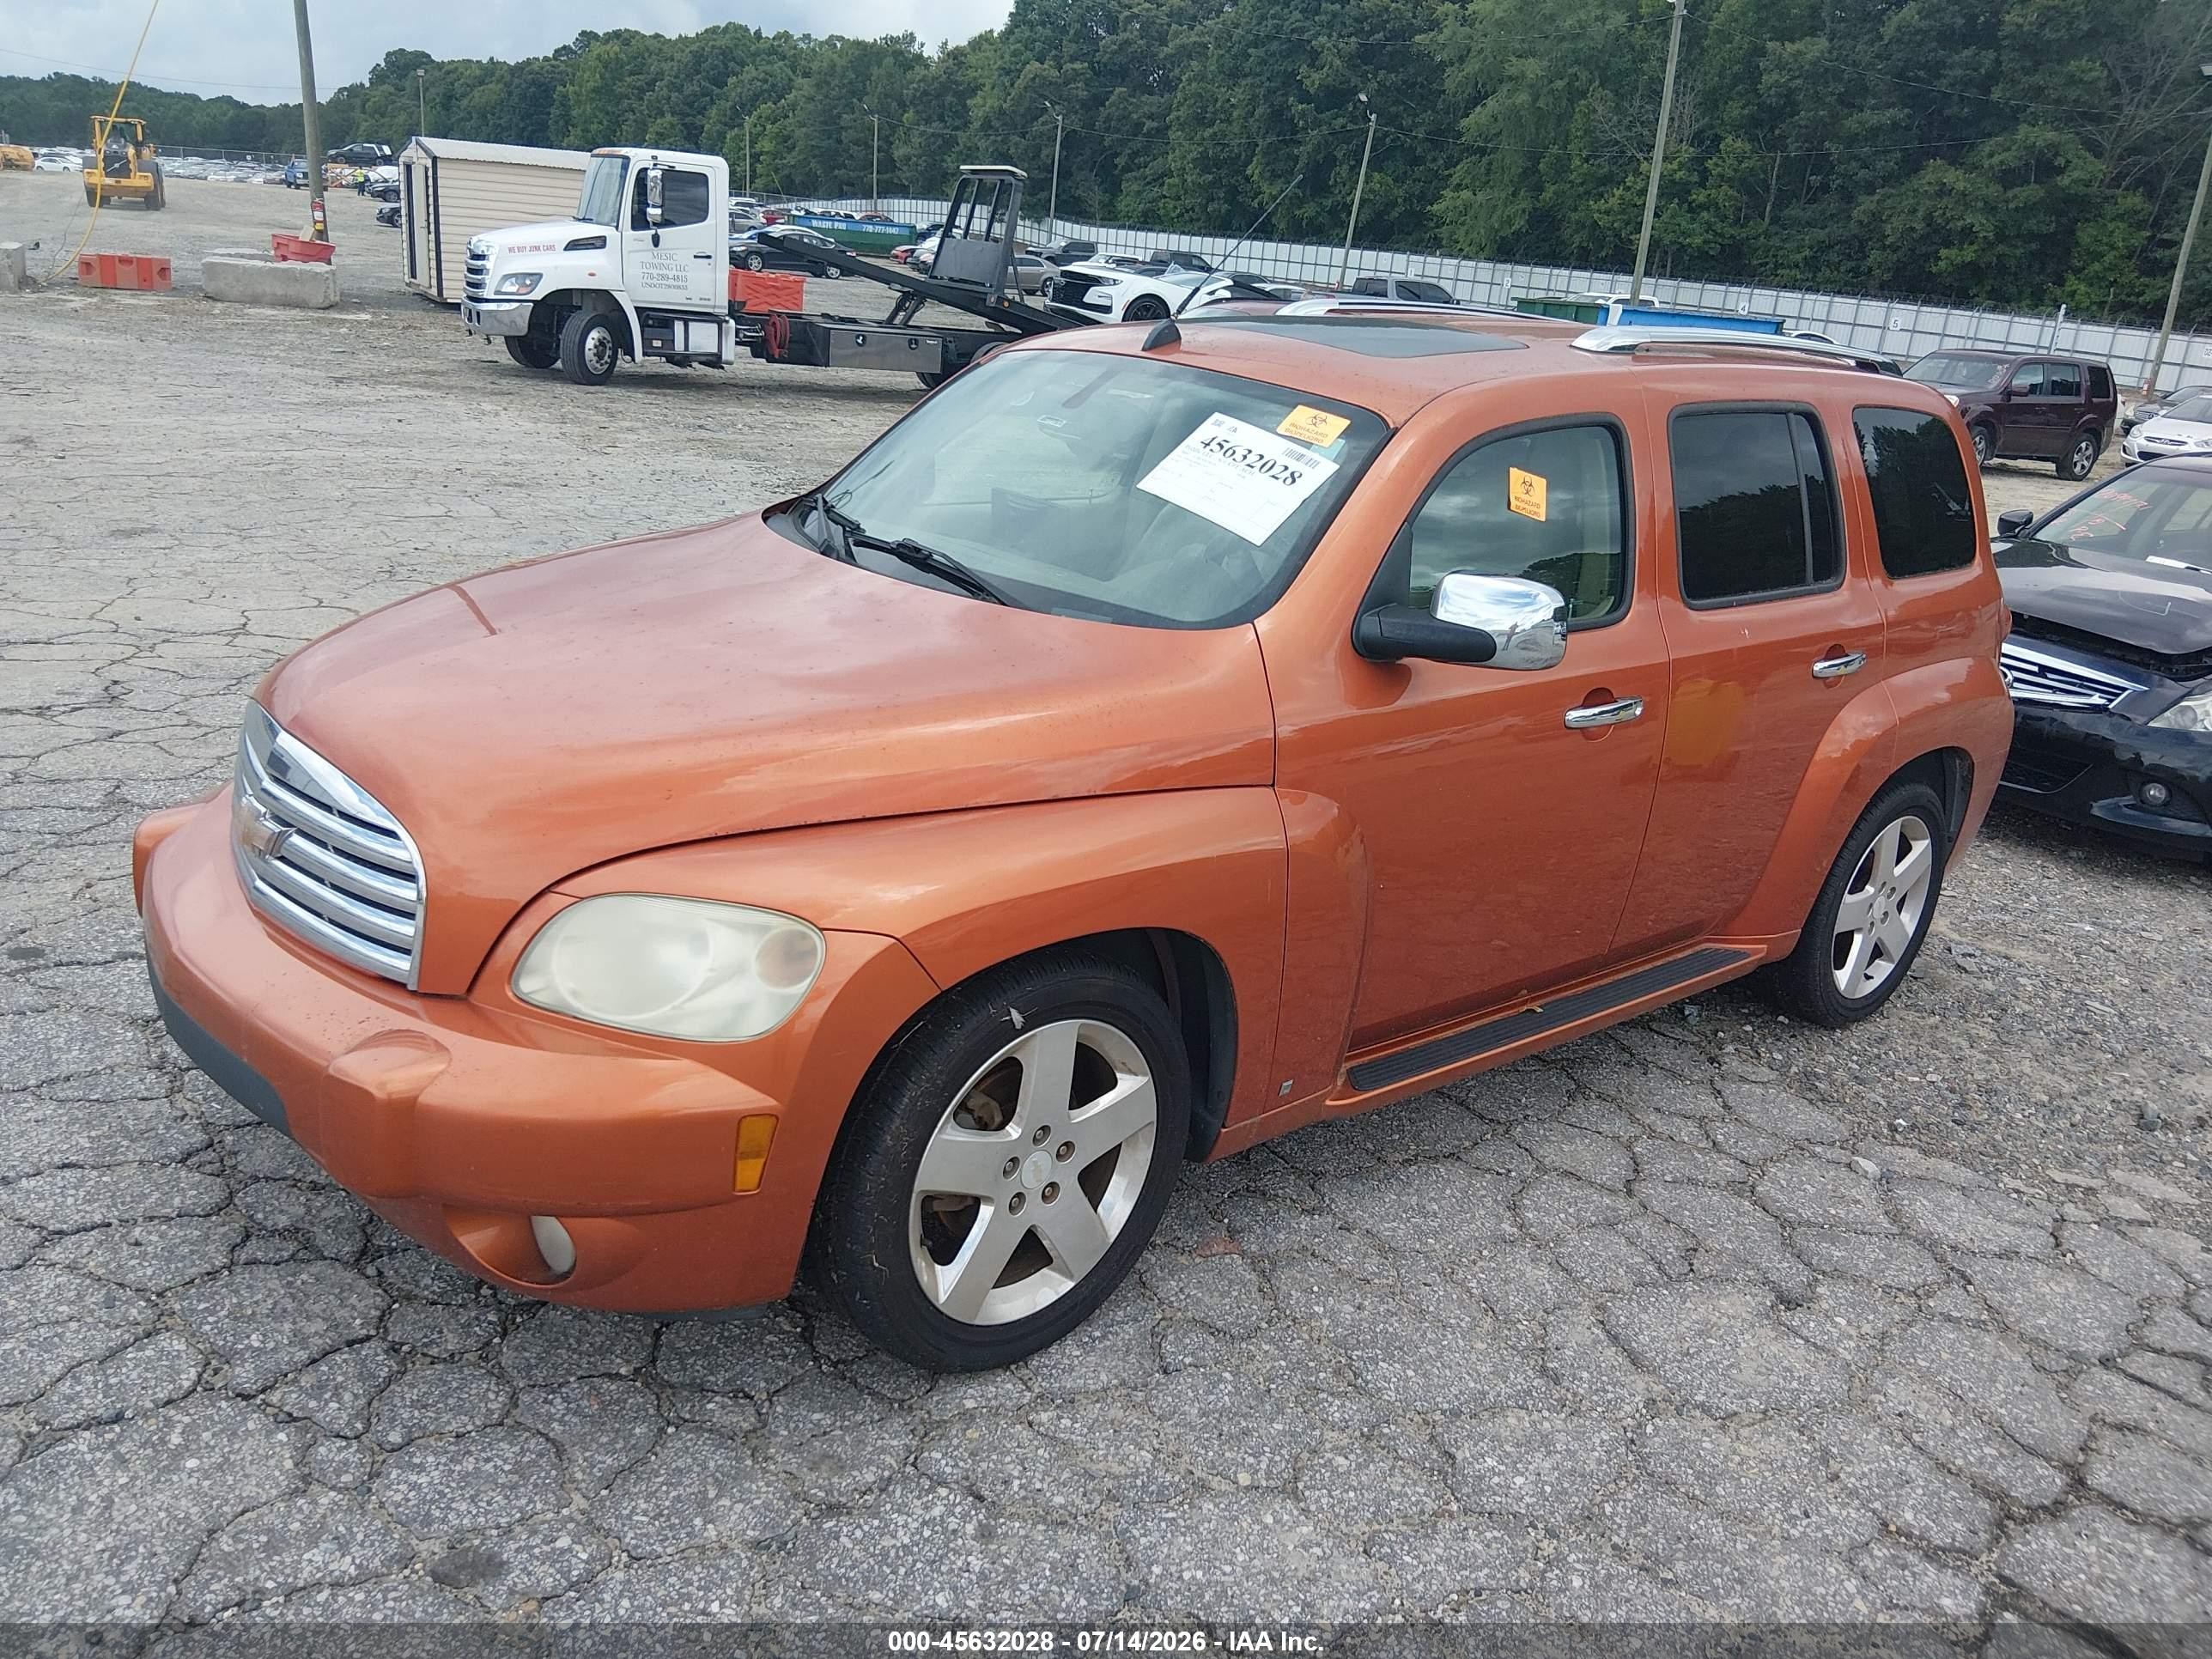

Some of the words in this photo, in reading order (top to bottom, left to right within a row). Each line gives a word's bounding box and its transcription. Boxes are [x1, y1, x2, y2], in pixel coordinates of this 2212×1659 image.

[812, 219, 832, 229] WASTE
[652, 251, 678, 261] MESIC
[640, 261, 673, 272] TOWING
[675, 263, 689, 273] LLC
[641, 272, 688, 283] 770-289-4815
[1289, 422, 1328, 439] BIOHAZARD
[1200, 435, 1303, 486] 45632028
